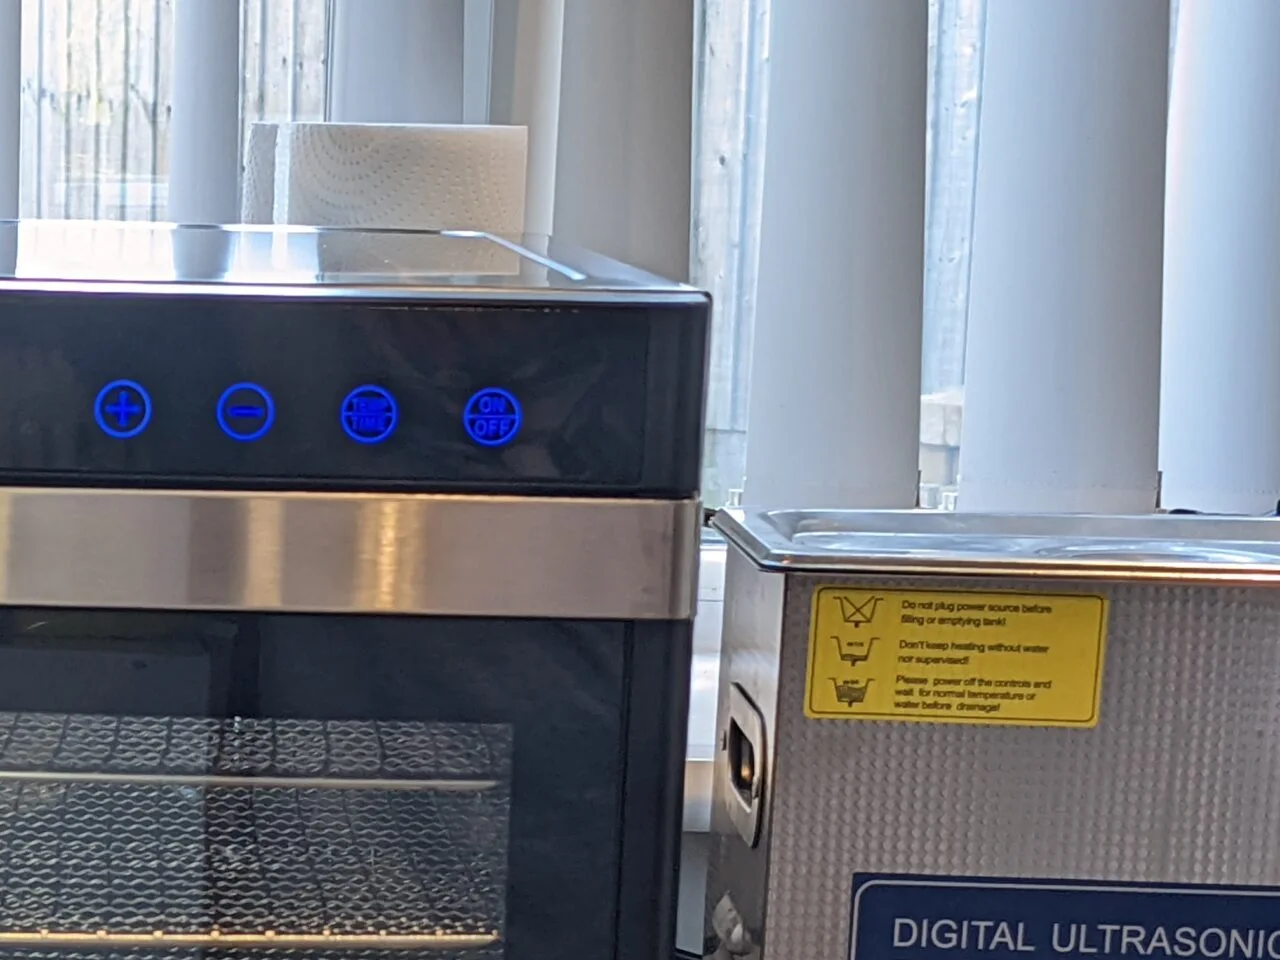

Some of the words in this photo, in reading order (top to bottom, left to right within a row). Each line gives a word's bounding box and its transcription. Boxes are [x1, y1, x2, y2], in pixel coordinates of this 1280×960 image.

[479, 396, 506, 413] ON
[474, 419, 510, 436] OFF
[901, 600, 916, 610] Do
[918, 601, 933, 610] not
[934, 602, 955, 613] plug
[956, 603, 986, 613] power
[988, 604, 1019, 613] source
[1021, 604, 1052, 613] before
[926, 616, 936, 624] or
[925, 641, 949, 651] keep
[951, 642, 984, 653] heating
[987, 644, 1020, 653] without
[897, 655, 913, 663] not
[895, 675, 928, 685] Please
[932, 678, 962, 687] power
[963, 678, 976, 686] off
[977, 678, 992, 687] the
[1033, 680, 1052, 689] and
[918, 688, 931, 697] for
[933, 689, 965, 698] normal
[894, 701, 920, 709] water
[921, 700, 952, 710] before
[892, 917, 1036, 952] DIGITAL
